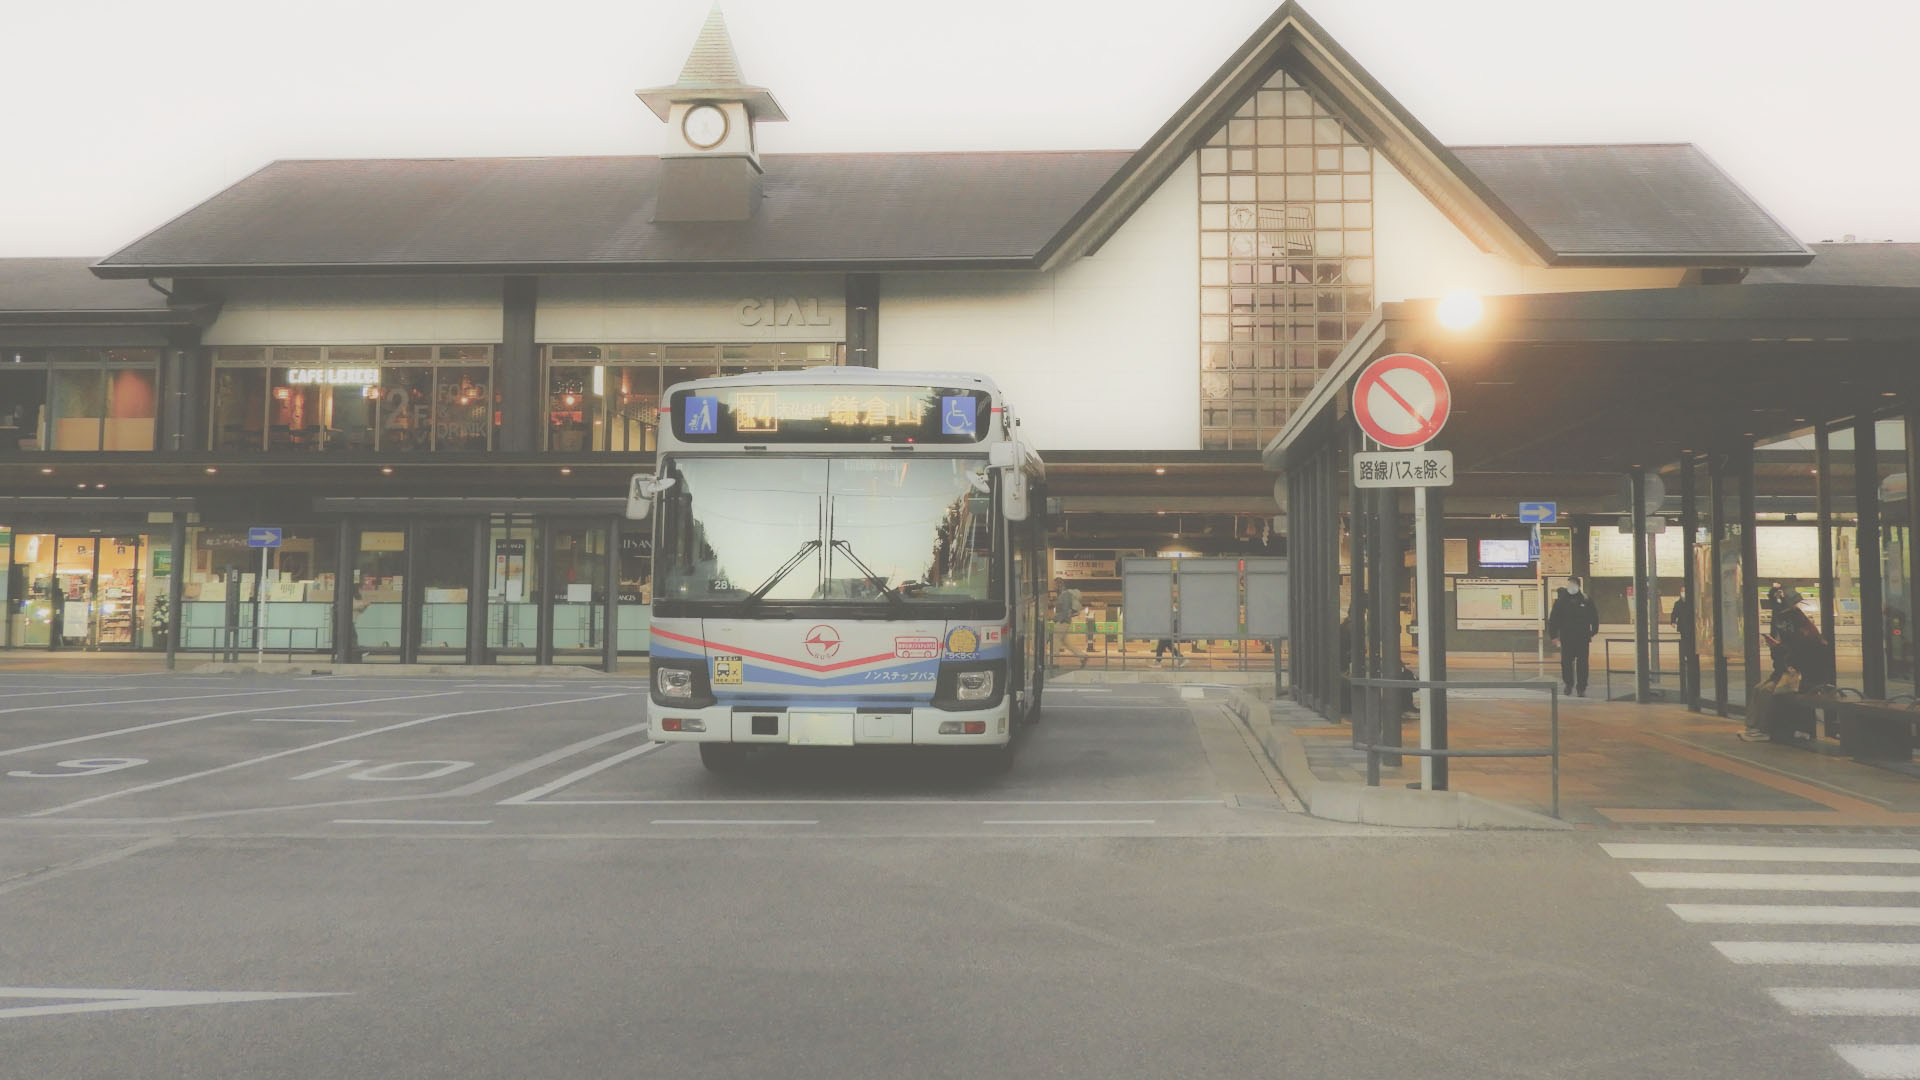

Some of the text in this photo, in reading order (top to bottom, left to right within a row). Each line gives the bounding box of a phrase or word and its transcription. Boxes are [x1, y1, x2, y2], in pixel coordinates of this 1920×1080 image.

[738, 296, 832, 327] CIAL
[288, 367, 325, 386] CAFE
[830, 395, 922, 426] 鎌倉山
[1359, 459, 1448, 481] 路線バスを除く
[864, 671, 937, 681] ノンステップバス
[6, 757, 151, 778] 9
[287, 759, 476, 781] 10
